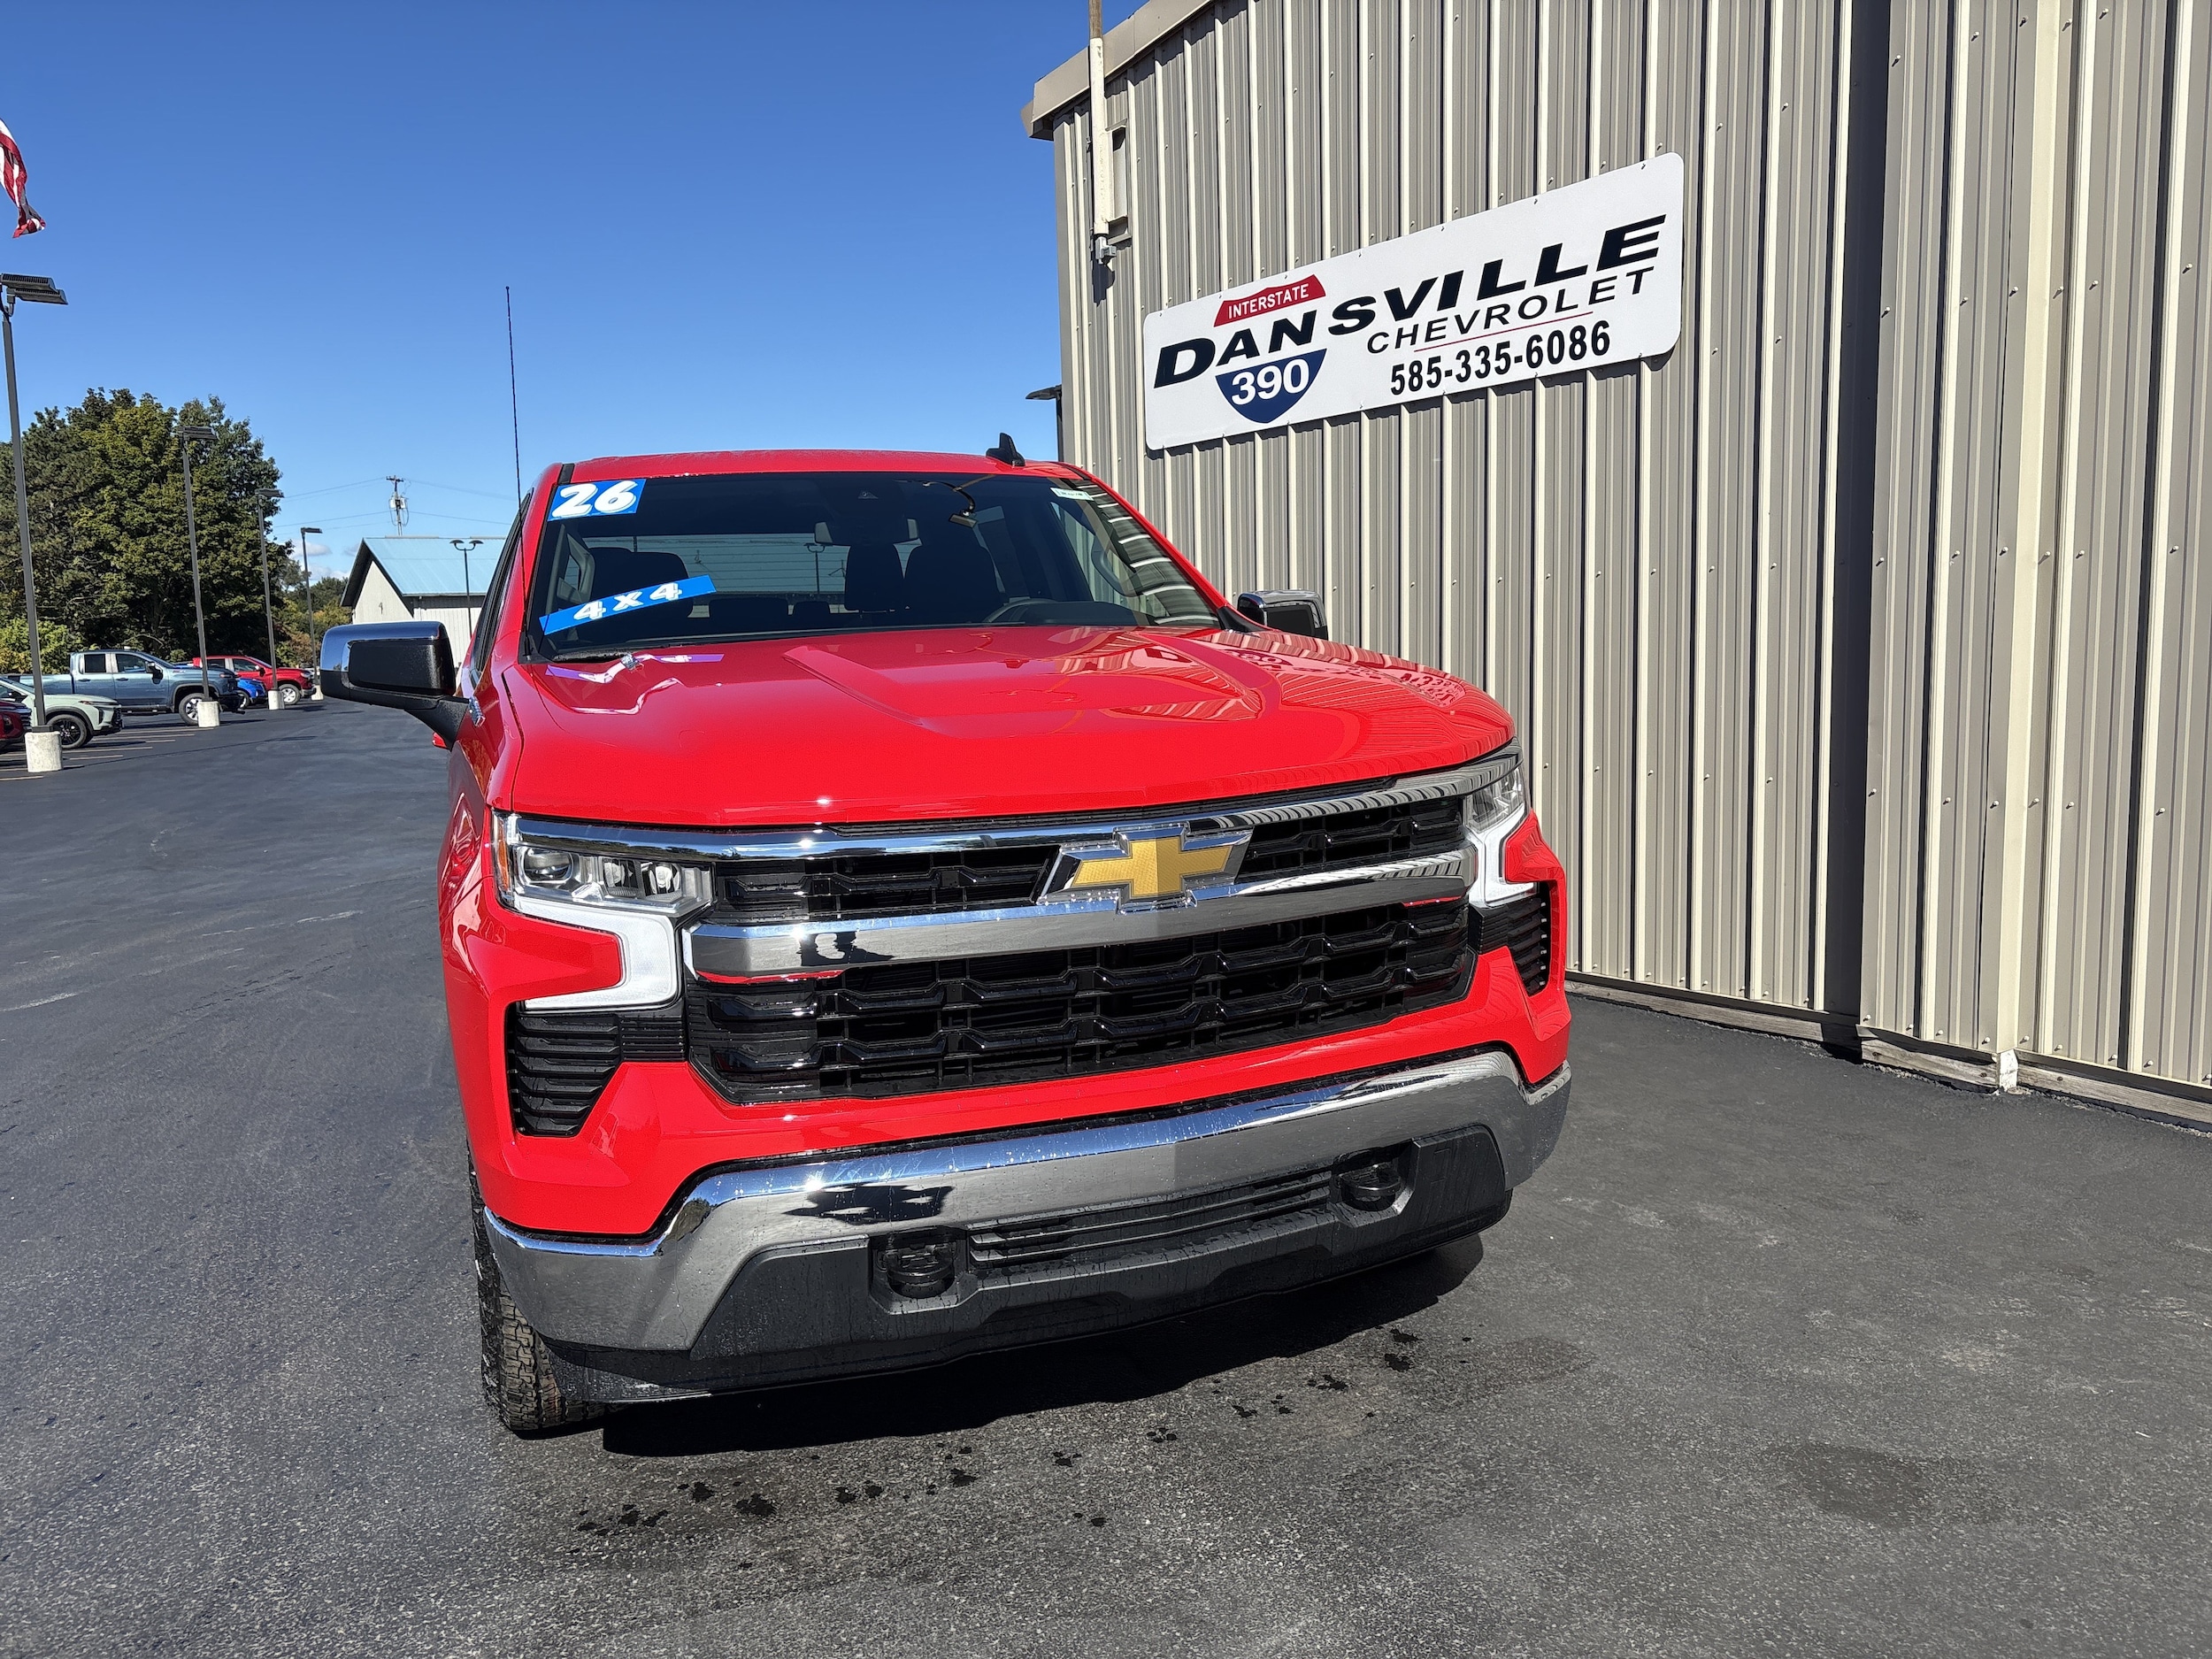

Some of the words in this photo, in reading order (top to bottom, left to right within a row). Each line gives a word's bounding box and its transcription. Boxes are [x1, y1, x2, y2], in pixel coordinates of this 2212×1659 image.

[1153, 213, 1667, 389] DANSVILLE
[1228, 283, 1310, 319] INTERSTATE
[1367, 265, 1655, 354] CHEVROLET
[1231, 358, 1310, 405] 390
[1390, 319, 1610, 396] 585-335-6086
[551, 480, 638, 518] 26
